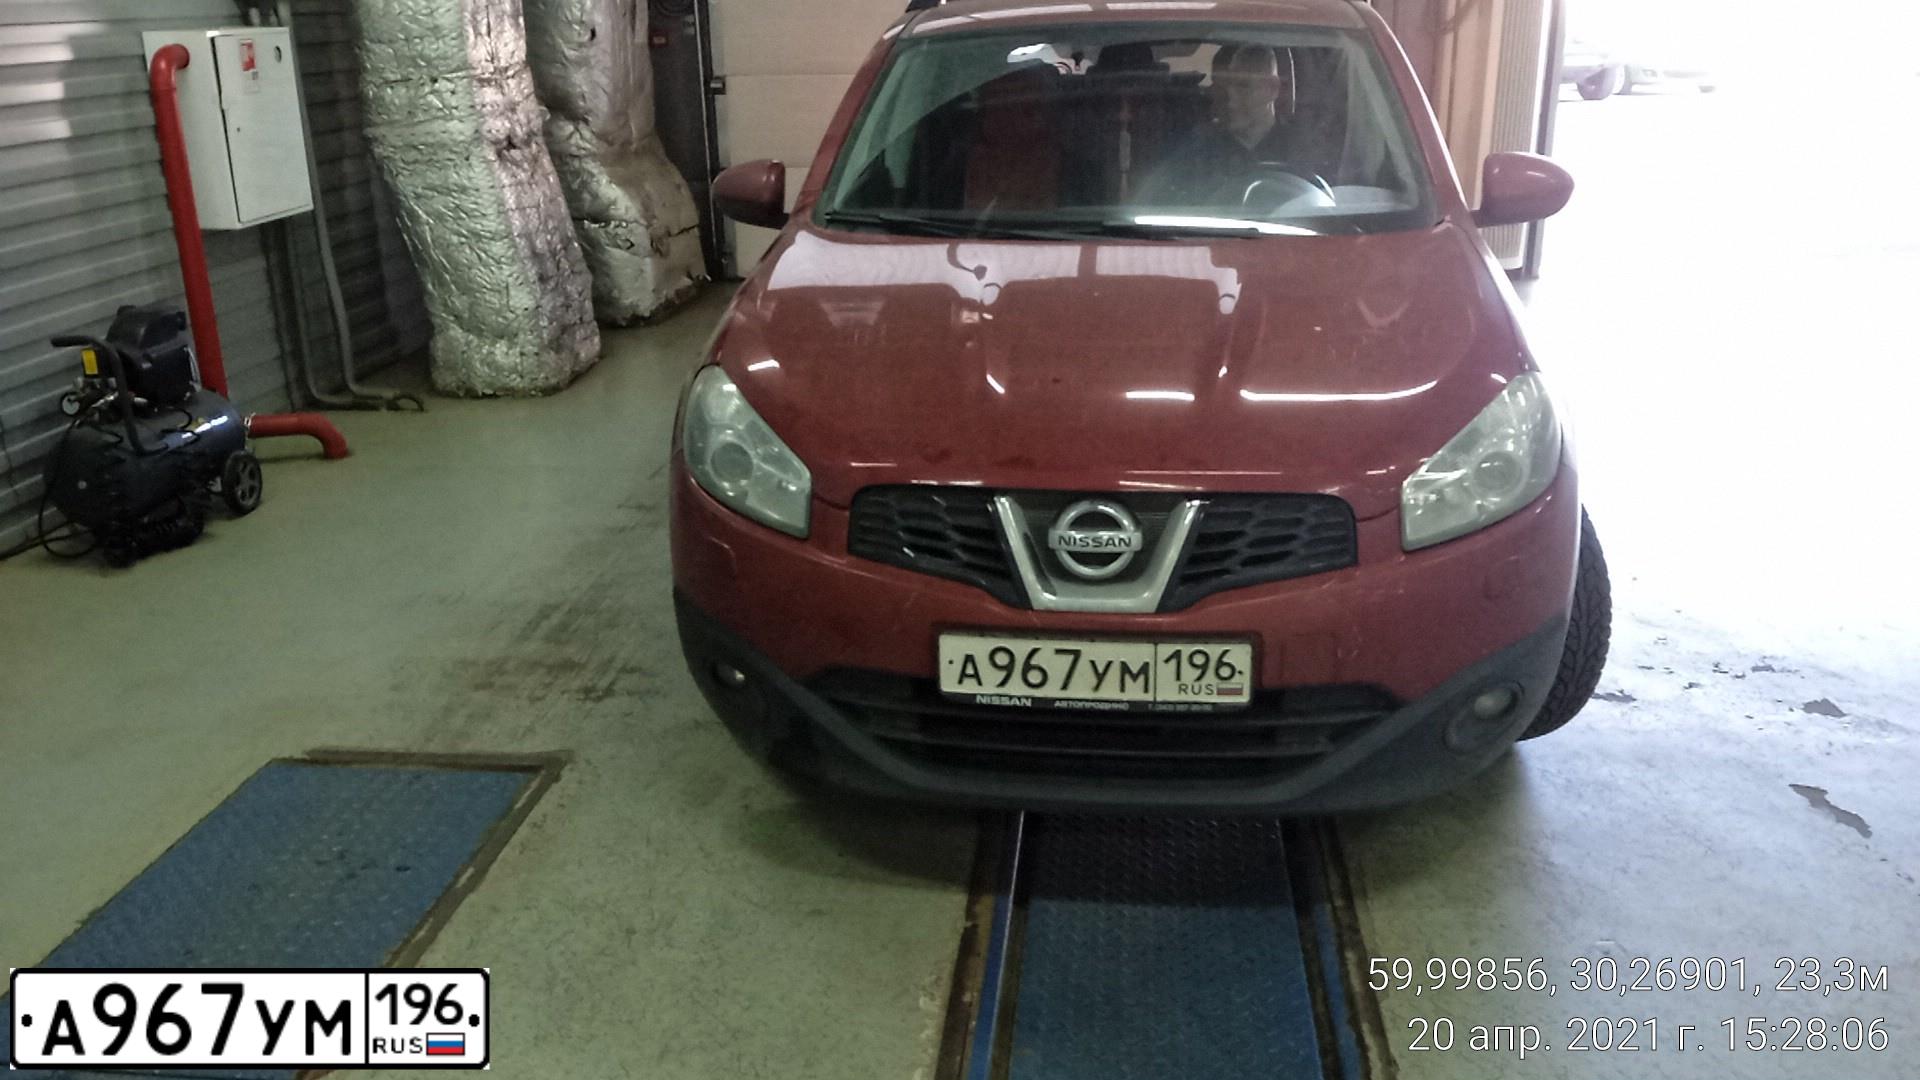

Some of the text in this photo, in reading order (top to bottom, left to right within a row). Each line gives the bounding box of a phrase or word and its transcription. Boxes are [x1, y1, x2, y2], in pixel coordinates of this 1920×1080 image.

[1058, 535, 1132, 548] NISSAN
[957, 645, 1237, 694] А967УМ 196
[1177, 683, 1215, 696] RUS
[975, 694, 1033, 707] NISSAN
